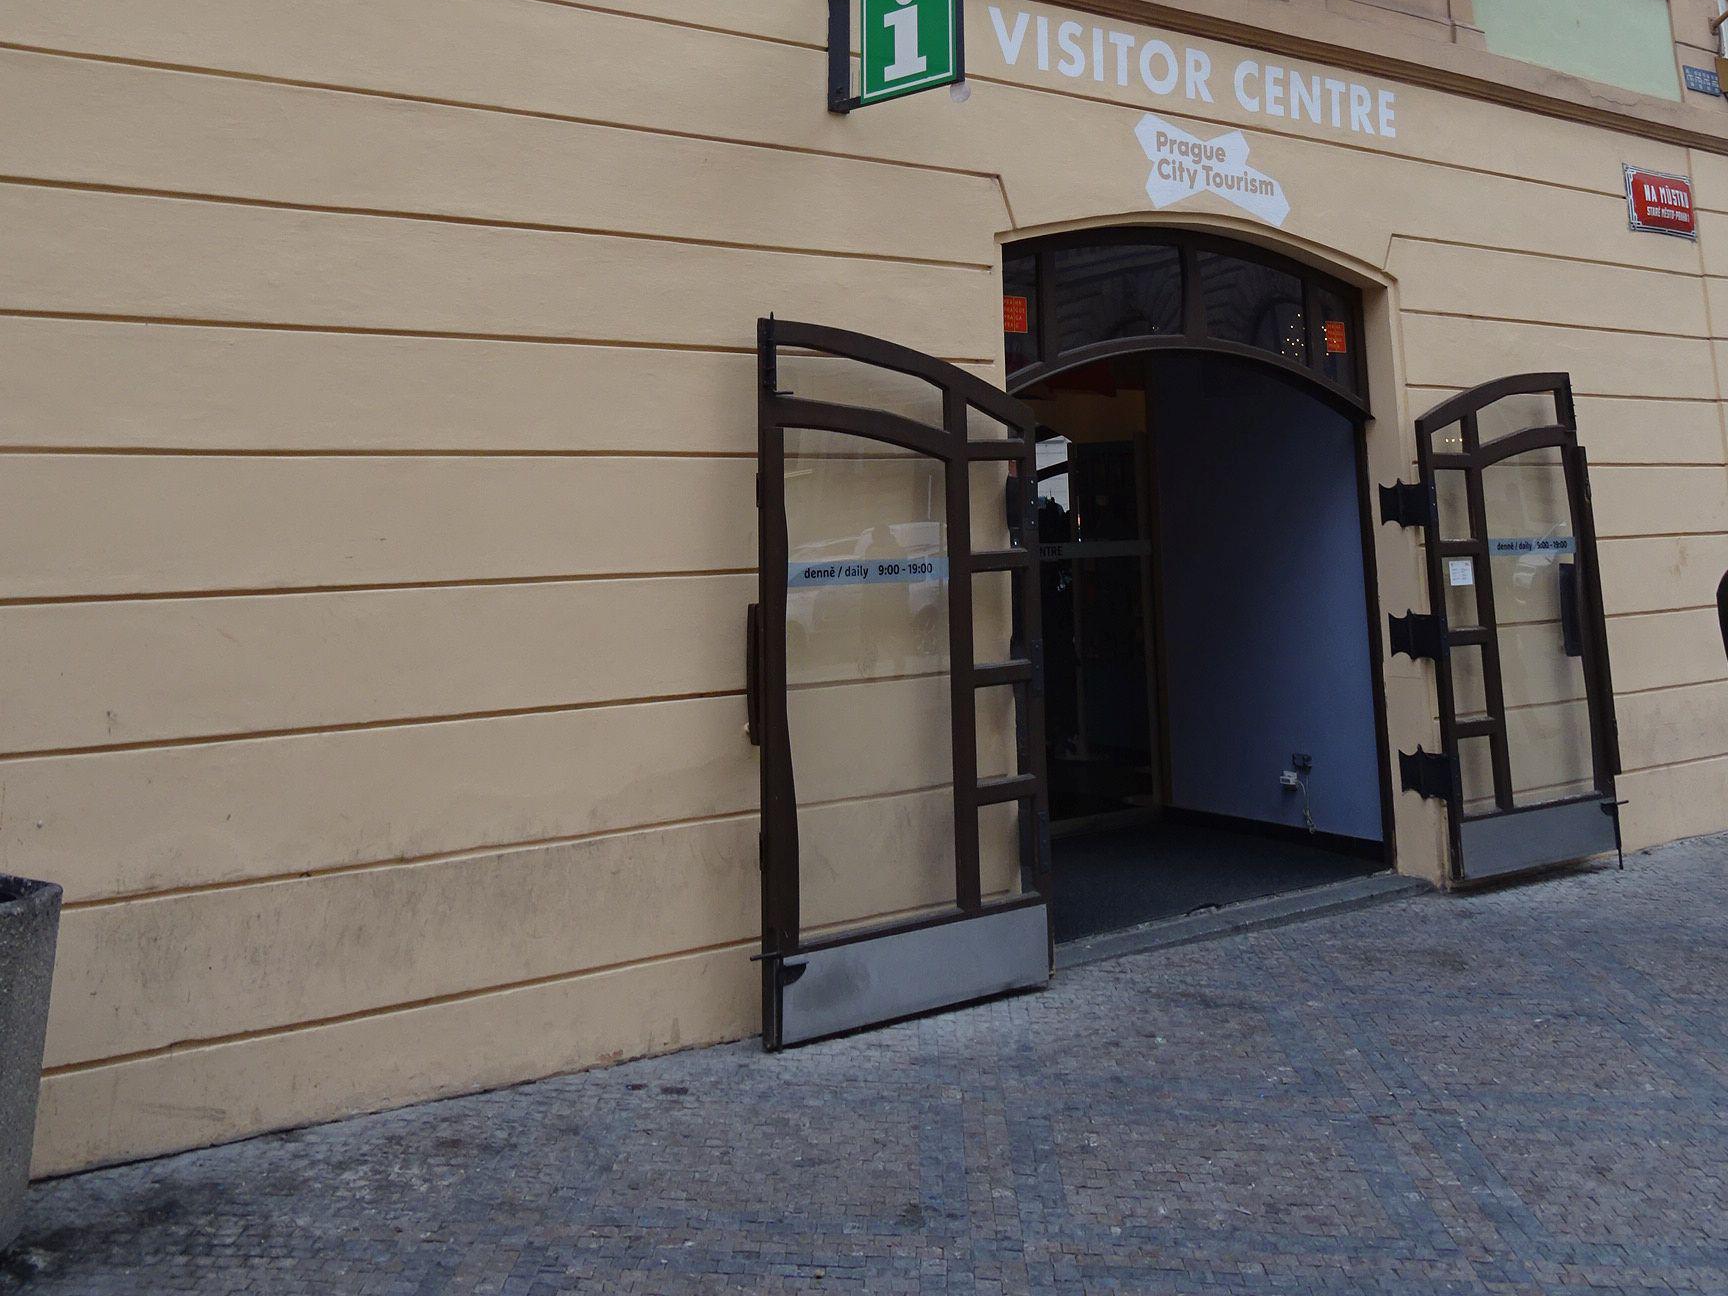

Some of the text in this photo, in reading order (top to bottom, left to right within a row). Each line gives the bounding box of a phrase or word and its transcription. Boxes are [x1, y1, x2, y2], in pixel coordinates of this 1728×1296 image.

[987, 6, 1397, 138] VISITOR CENTRE
[1156, 131, 1226, 164] Prague
[1157, 158, 1275, 196] City Tourism
[1643, 184, 1658, 202] NA
[1039, 545, 1063, 557] NTRE
[804, 566, 836, 580] denně
[844, 565, 869, 578] daily
[878, 564, 900, 576] 9:00
[908, 562, 933, 575] 19:00
